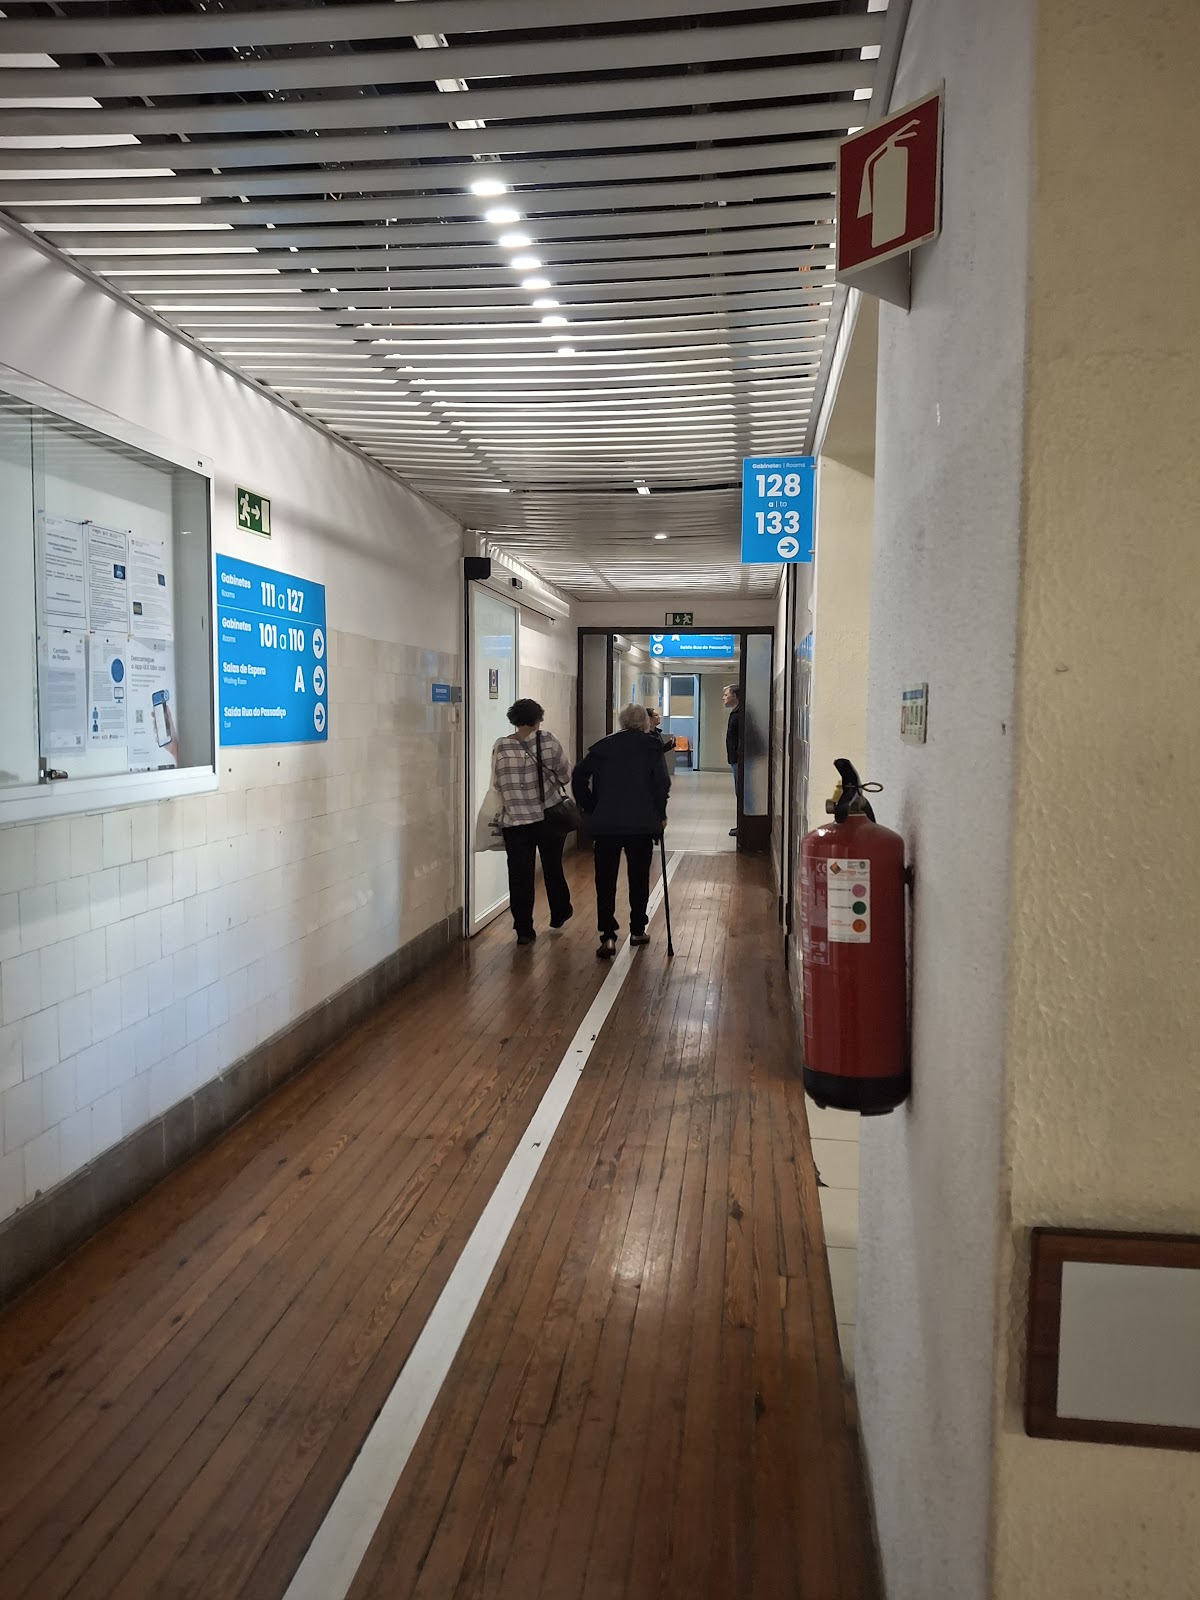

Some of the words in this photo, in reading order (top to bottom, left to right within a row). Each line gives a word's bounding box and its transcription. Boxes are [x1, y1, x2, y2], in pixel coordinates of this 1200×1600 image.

[756, 473, 800, 497] 128
[755, 511, 800, 534] 133
[221, 572, 251, 589] Gabinetes
[261, 582, 275, 608] 111
[278, 594, 286, 610] a
[287, 588, 304, 613] 127
[222, 617, 251, 632] Gabinetes
[259, 623, 277, 649] 101
[280, 634, 286, 650] a
[289, 628, 305, 652] 110
[223, 662, 239, 673] Salas
[240, 664, 247, 674] de
[248, 664, 266, 677] Espera
[294, 666, 305, 693] A
[224, 706, 241, 717] Saída
[242, 707, 252, 717] Rua
[253, 707, 260, 717] do
[261, 706, 286, 719] Passadiço
